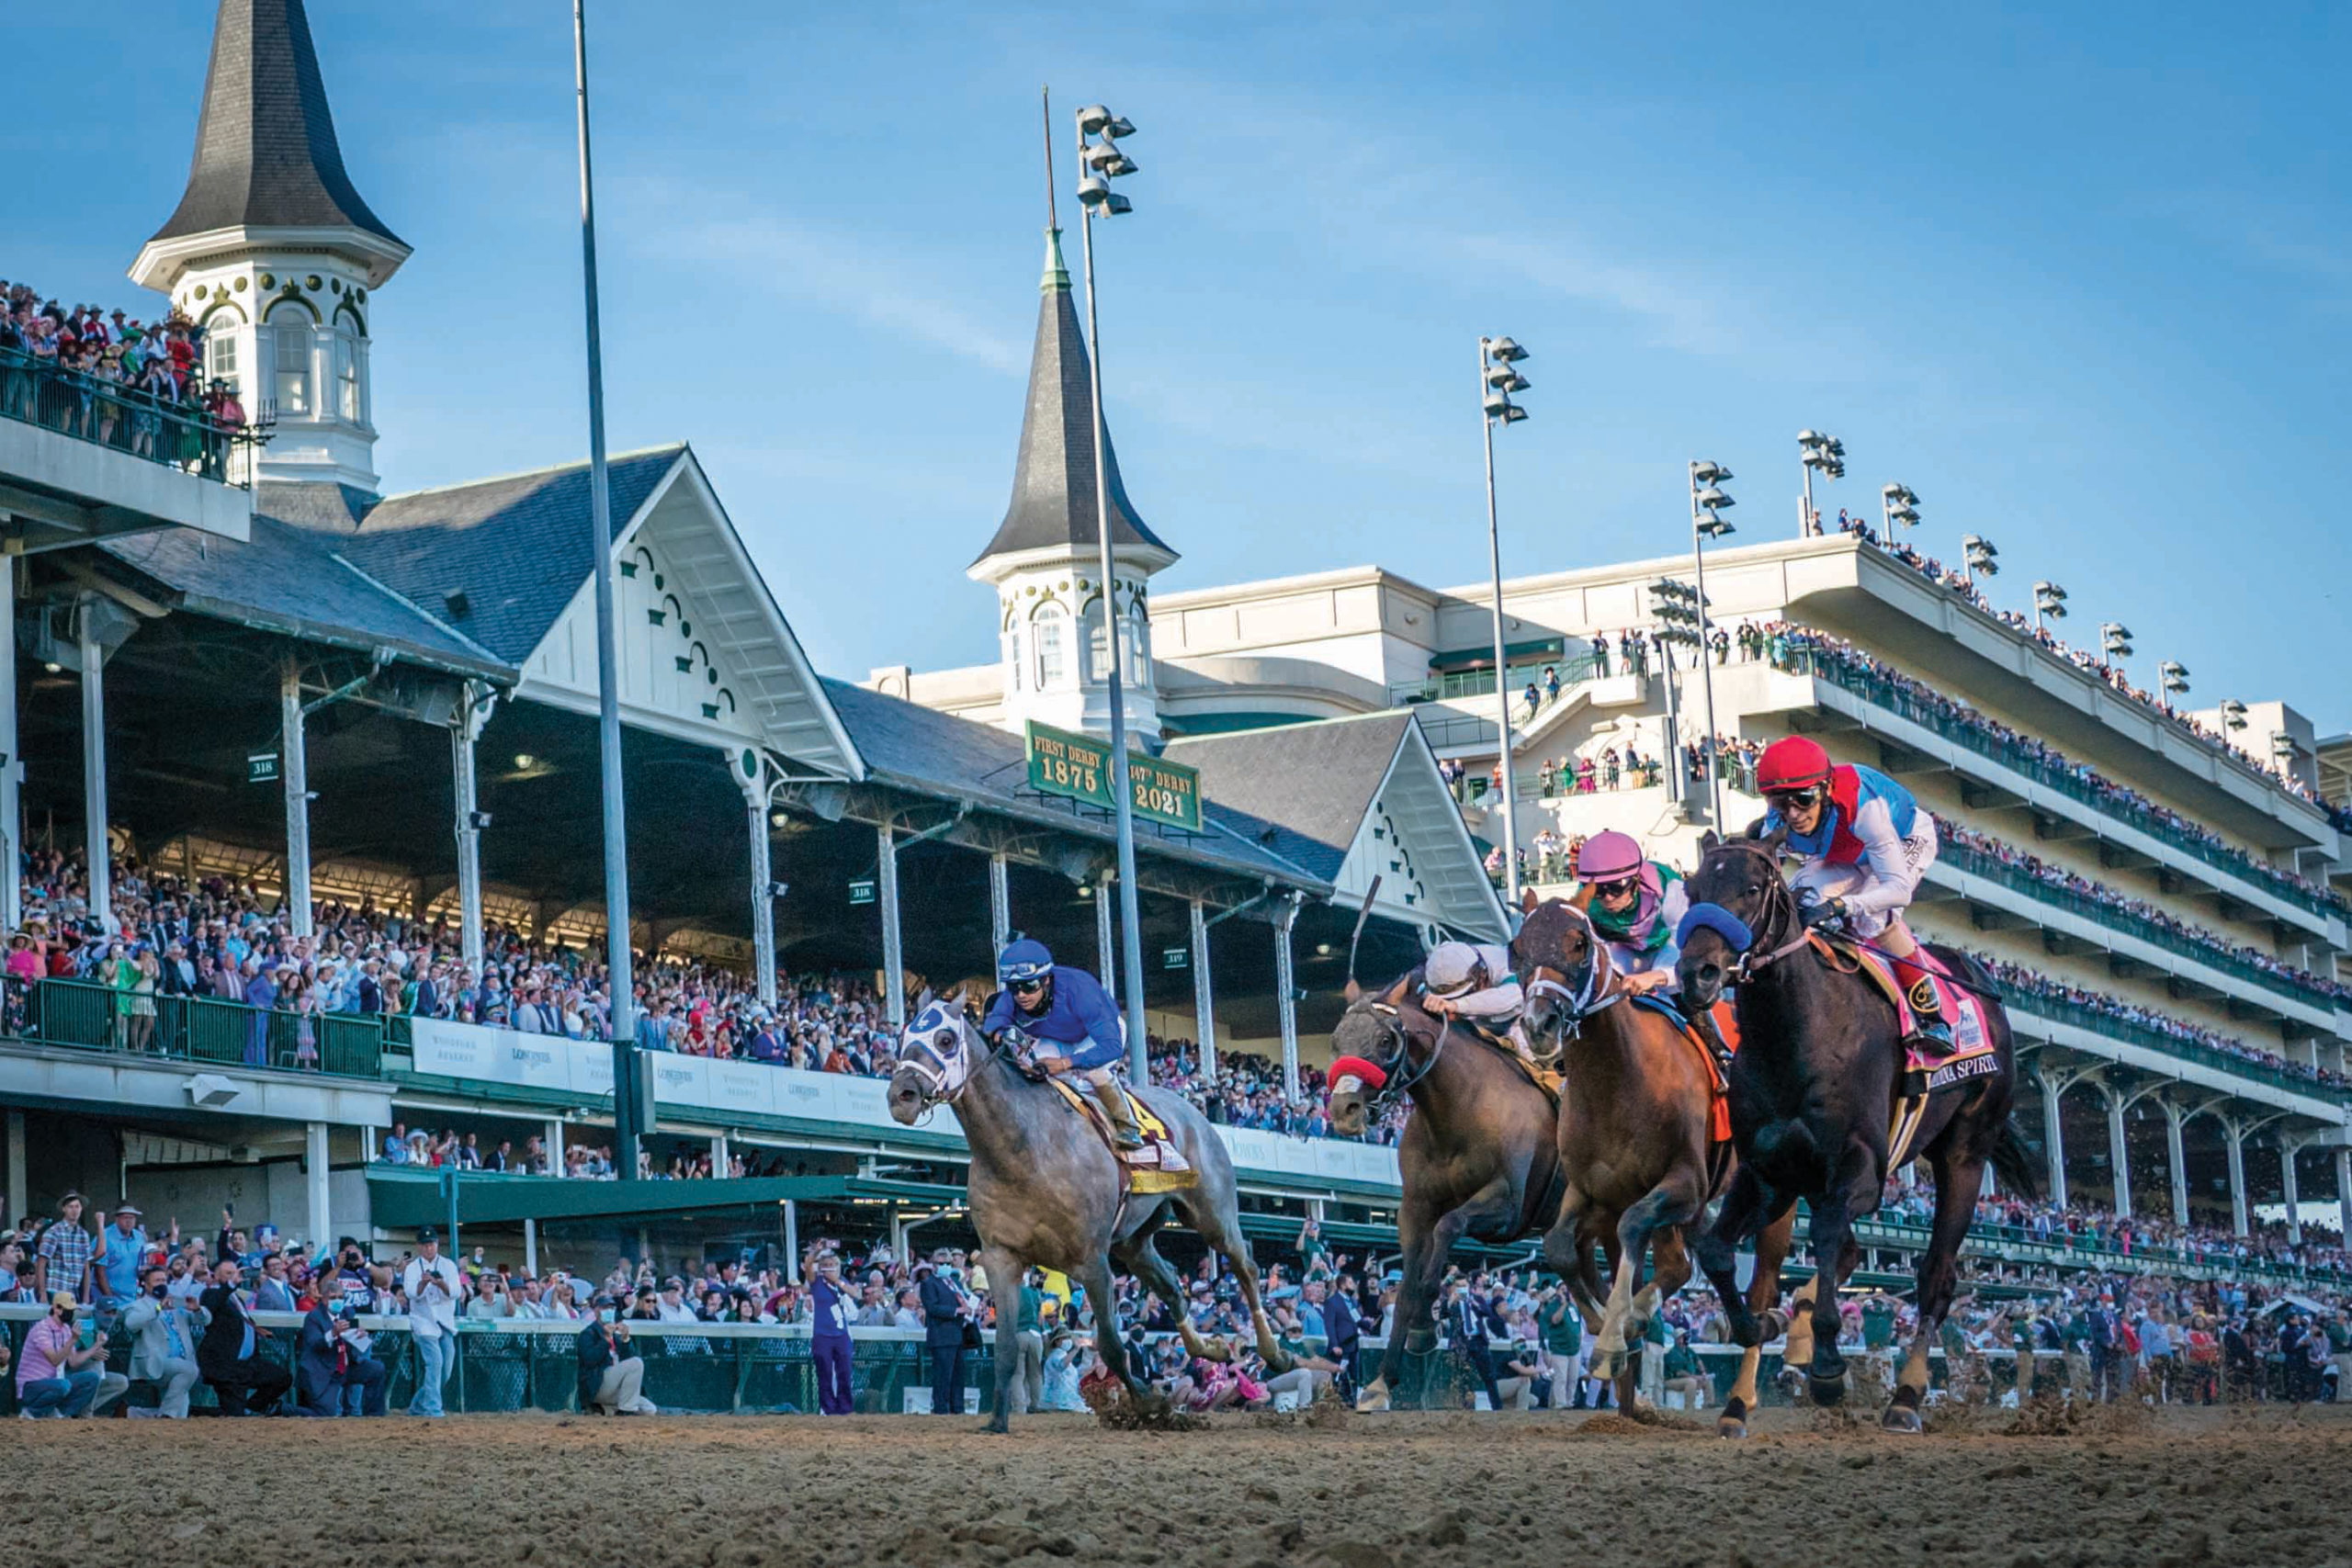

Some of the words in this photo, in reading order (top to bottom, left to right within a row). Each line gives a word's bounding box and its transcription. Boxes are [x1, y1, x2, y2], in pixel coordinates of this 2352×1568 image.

[254, 761, 273, 774] 318
[1034, 735, 1064, 759] FIRST
[1068, 744, 1100, 769] DERBY
[1042, 757, 1097, 794] 1875
[1155, 771, 1192, 795] DERBY
[1136, 784, 1184, 818] 2021
